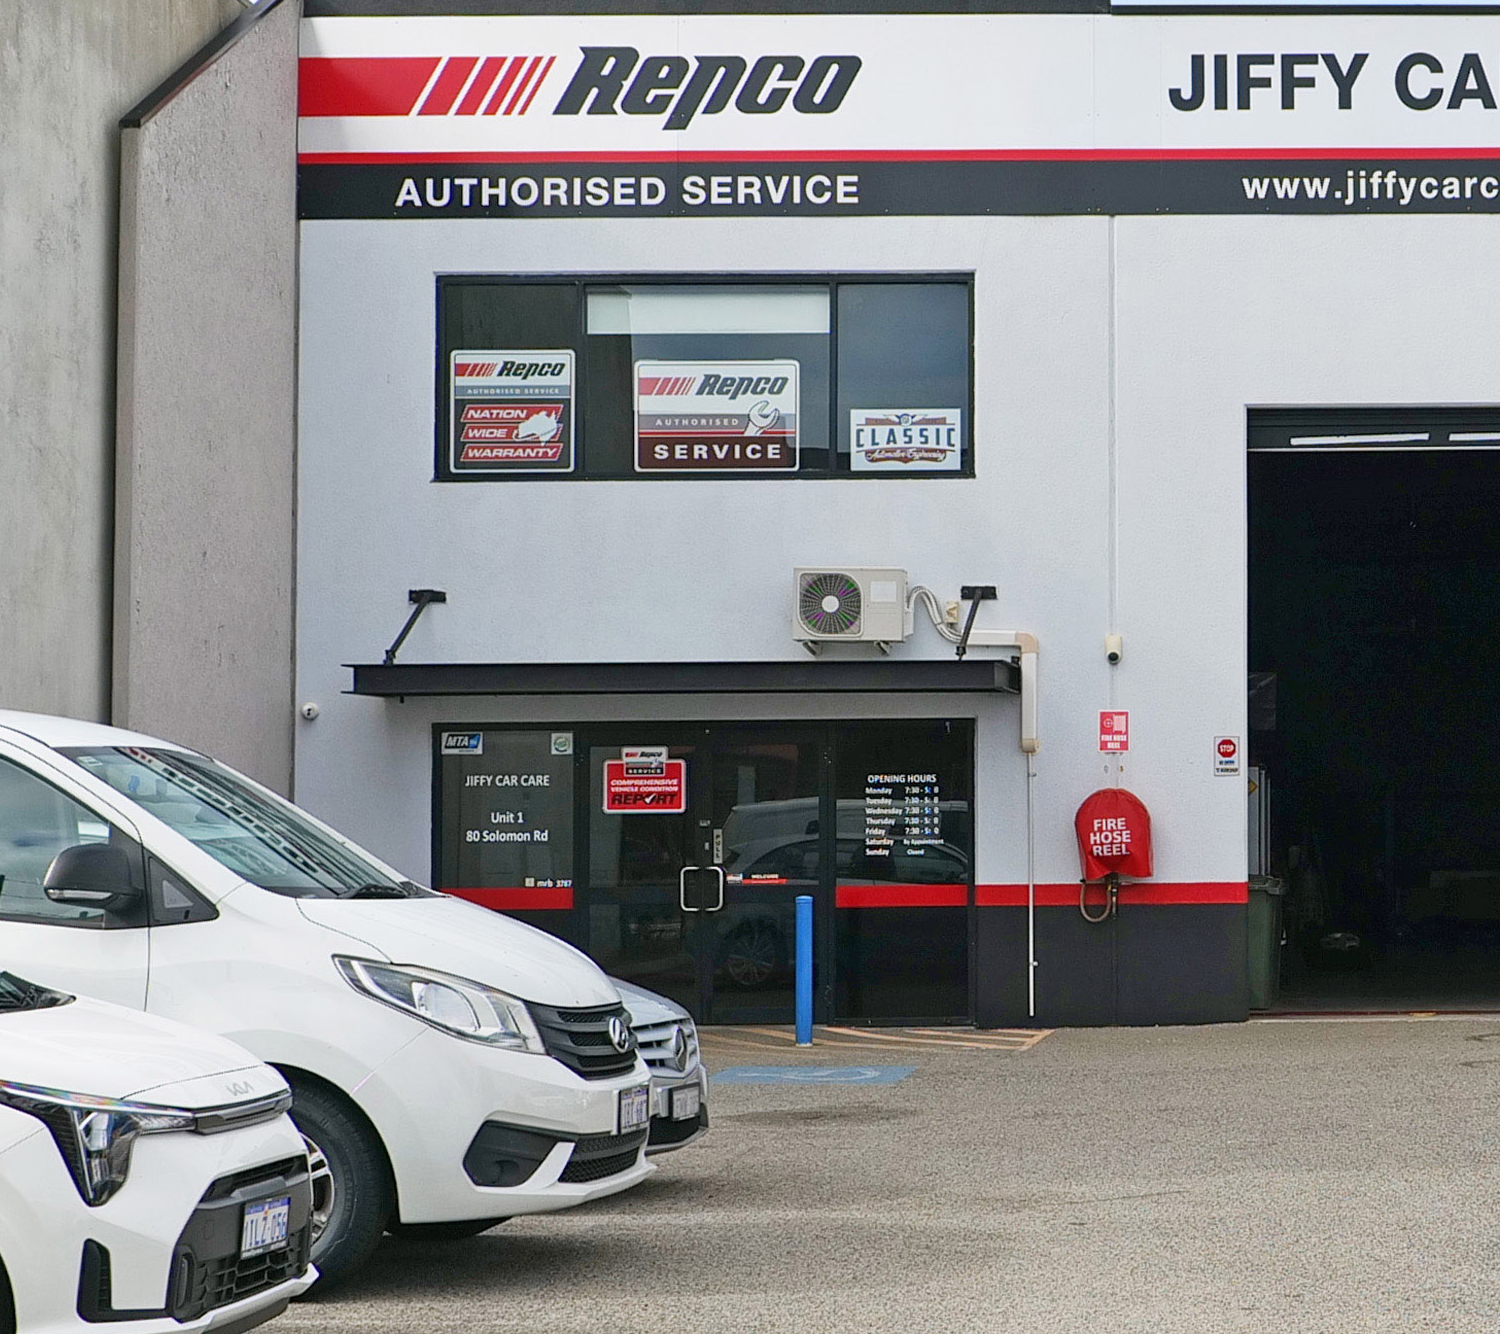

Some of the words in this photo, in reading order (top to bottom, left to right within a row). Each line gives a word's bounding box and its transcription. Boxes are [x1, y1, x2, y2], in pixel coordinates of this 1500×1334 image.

[1168, 52, 1369, 111] JIFFY
[553, 46, 863, 131] Repco
[396, 175, 667, 207] AUTHORISED
[681, 174, 860, 206] SERVICE
[497, 360, 566, 380] Repco
[695, 373, 789, 400] Repco
[467, 409, 528, 419] NATION
[655, 418, 739, 426] AUTHORISED
[468, 428, 508, 438] WIDE
[856, 428, 956, 448] CLASSIC
[467, 448, 558, 458] WARRANTY
[653, 444, 781, 460] SERVICE
[446, 735, 469, 747] MTA
[464, 775, 493, 787] JIFFY
[494, 775, 518, 786] CAR
[520, 775, 550, 786] CARE
[867, 774, 906, 783] OPENING
[907, 774, 937, 783] HOURS
[490, 811, 515, 823] Unit
[516, 811, 523, 823] 1
[1093, 818, 1126, 831] FIRE
[466, 830, 481, 842] 80
[482, 829, 531, 842] Solomon
[533, 829, 549, 842] Rd
[1089, 830, 1132, 845] HOSE
[1092, 844, 1131, 857] REEL
